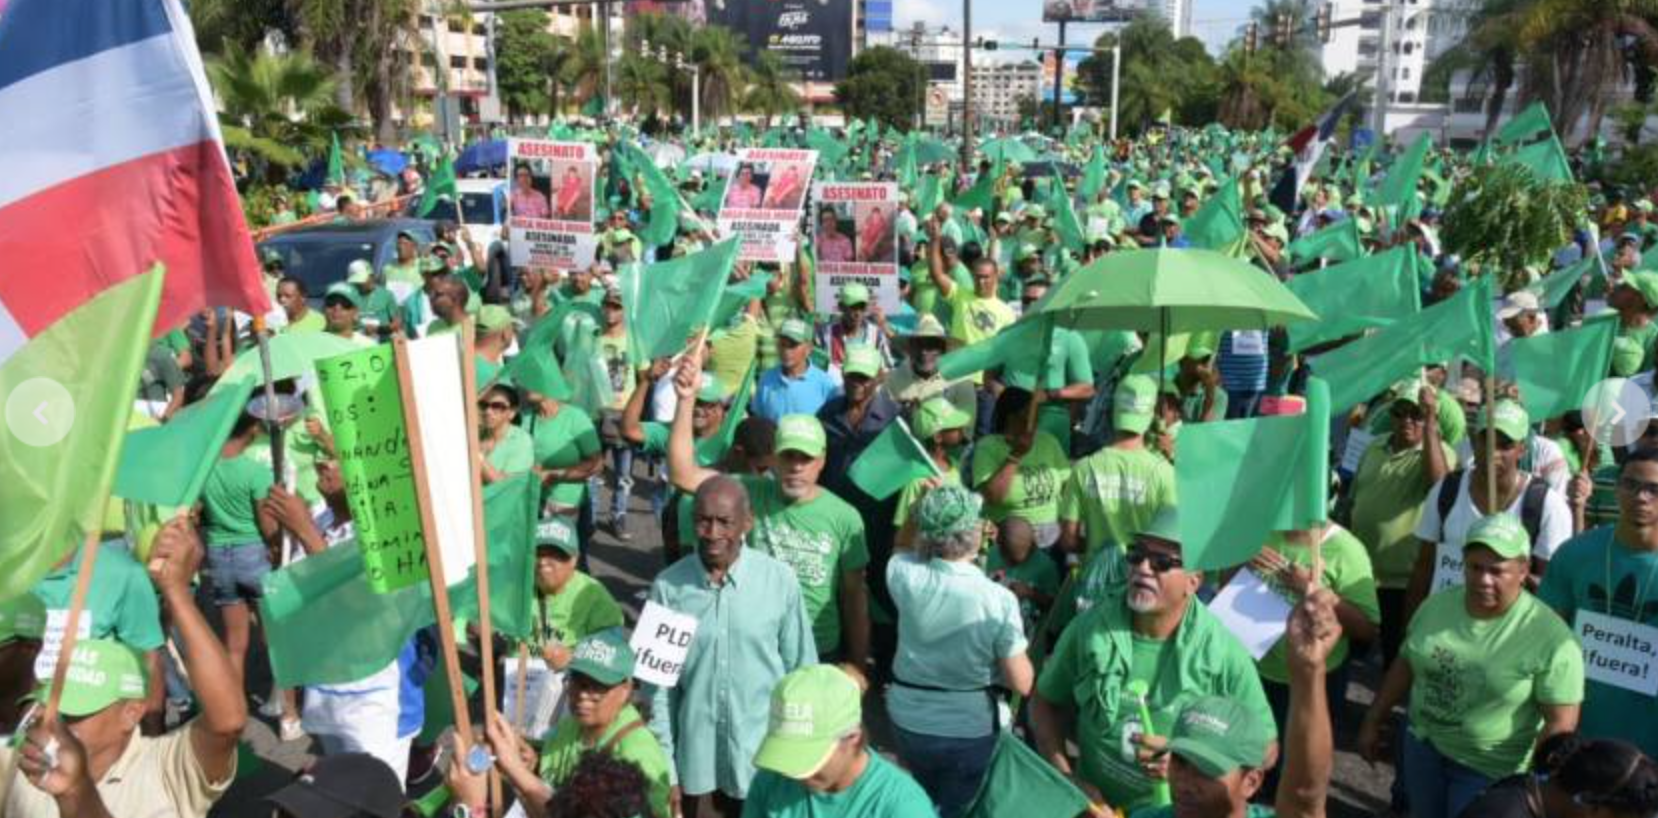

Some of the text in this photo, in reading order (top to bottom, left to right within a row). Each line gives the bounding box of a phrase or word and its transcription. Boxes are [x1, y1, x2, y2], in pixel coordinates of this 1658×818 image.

[518, 143, 585, 159] ASESINATO
[747, 149, 809, 160] ASESINATO
[823, 186, 887, 199] ASESINATO
[730, 221, 780, 232] ASESINADA
[525, 231, 577, 245] ASESINADA
[655, 622, 692, 649] PLD
[1582, 622, 1657, 657] Peralta,
